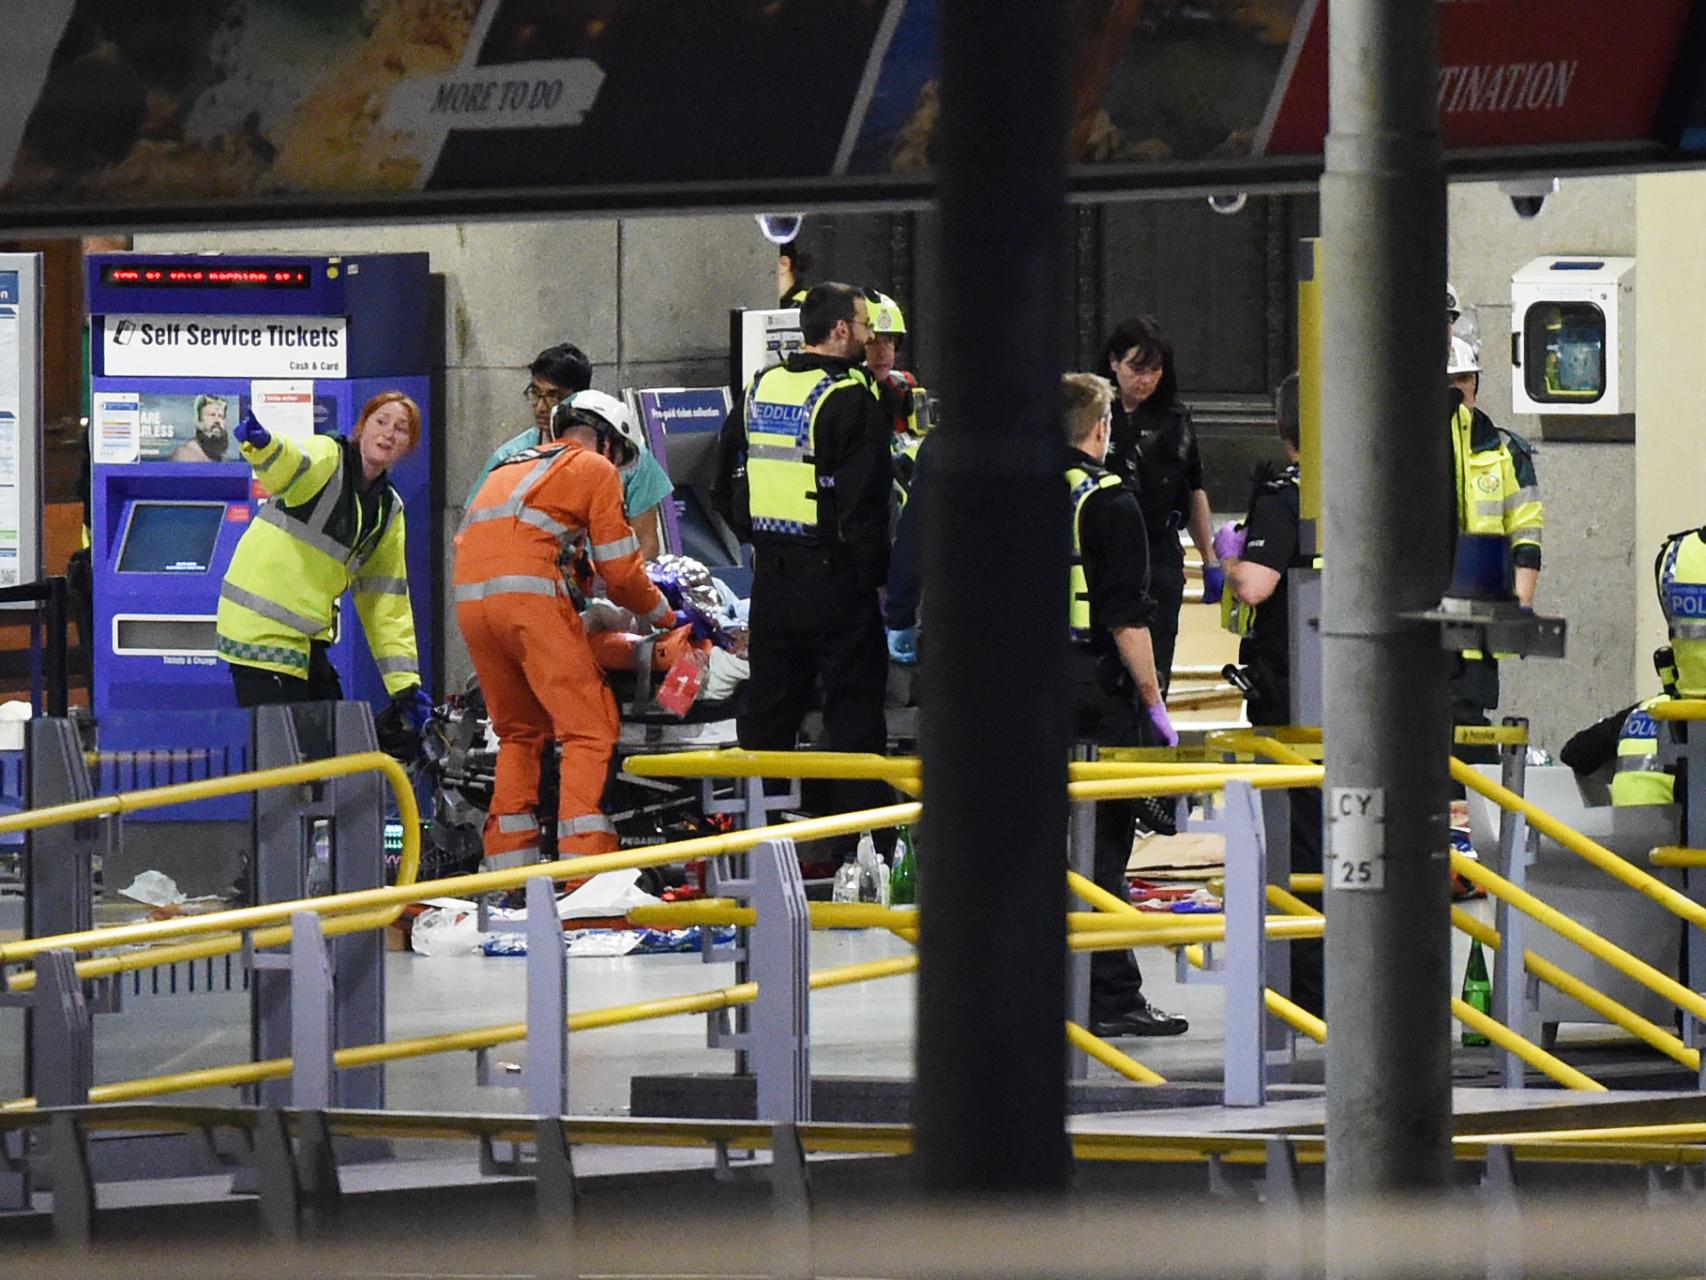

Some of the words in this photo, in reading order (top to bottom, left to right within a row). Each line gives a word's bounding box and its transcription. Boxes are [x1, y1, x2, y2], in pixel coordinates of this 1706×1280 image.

[430, 81, 497, 112] MORE
[499, 80, 529, 111] TO
[529, 79, 563, 109] DO
[141, 323, 180, 346] Self
[187, 323, 262, 347] Service
[266, 324, 339, 347] Tickets
[289, 361, 310, 371] Cash
[311, 361, 318, 371] &
[320, 361, 339, 371] Card
[1672, 595, 1706, 614] POL
[1340, 793, 1372, 815] CY
[1343, 861, 1372, 882] 25
